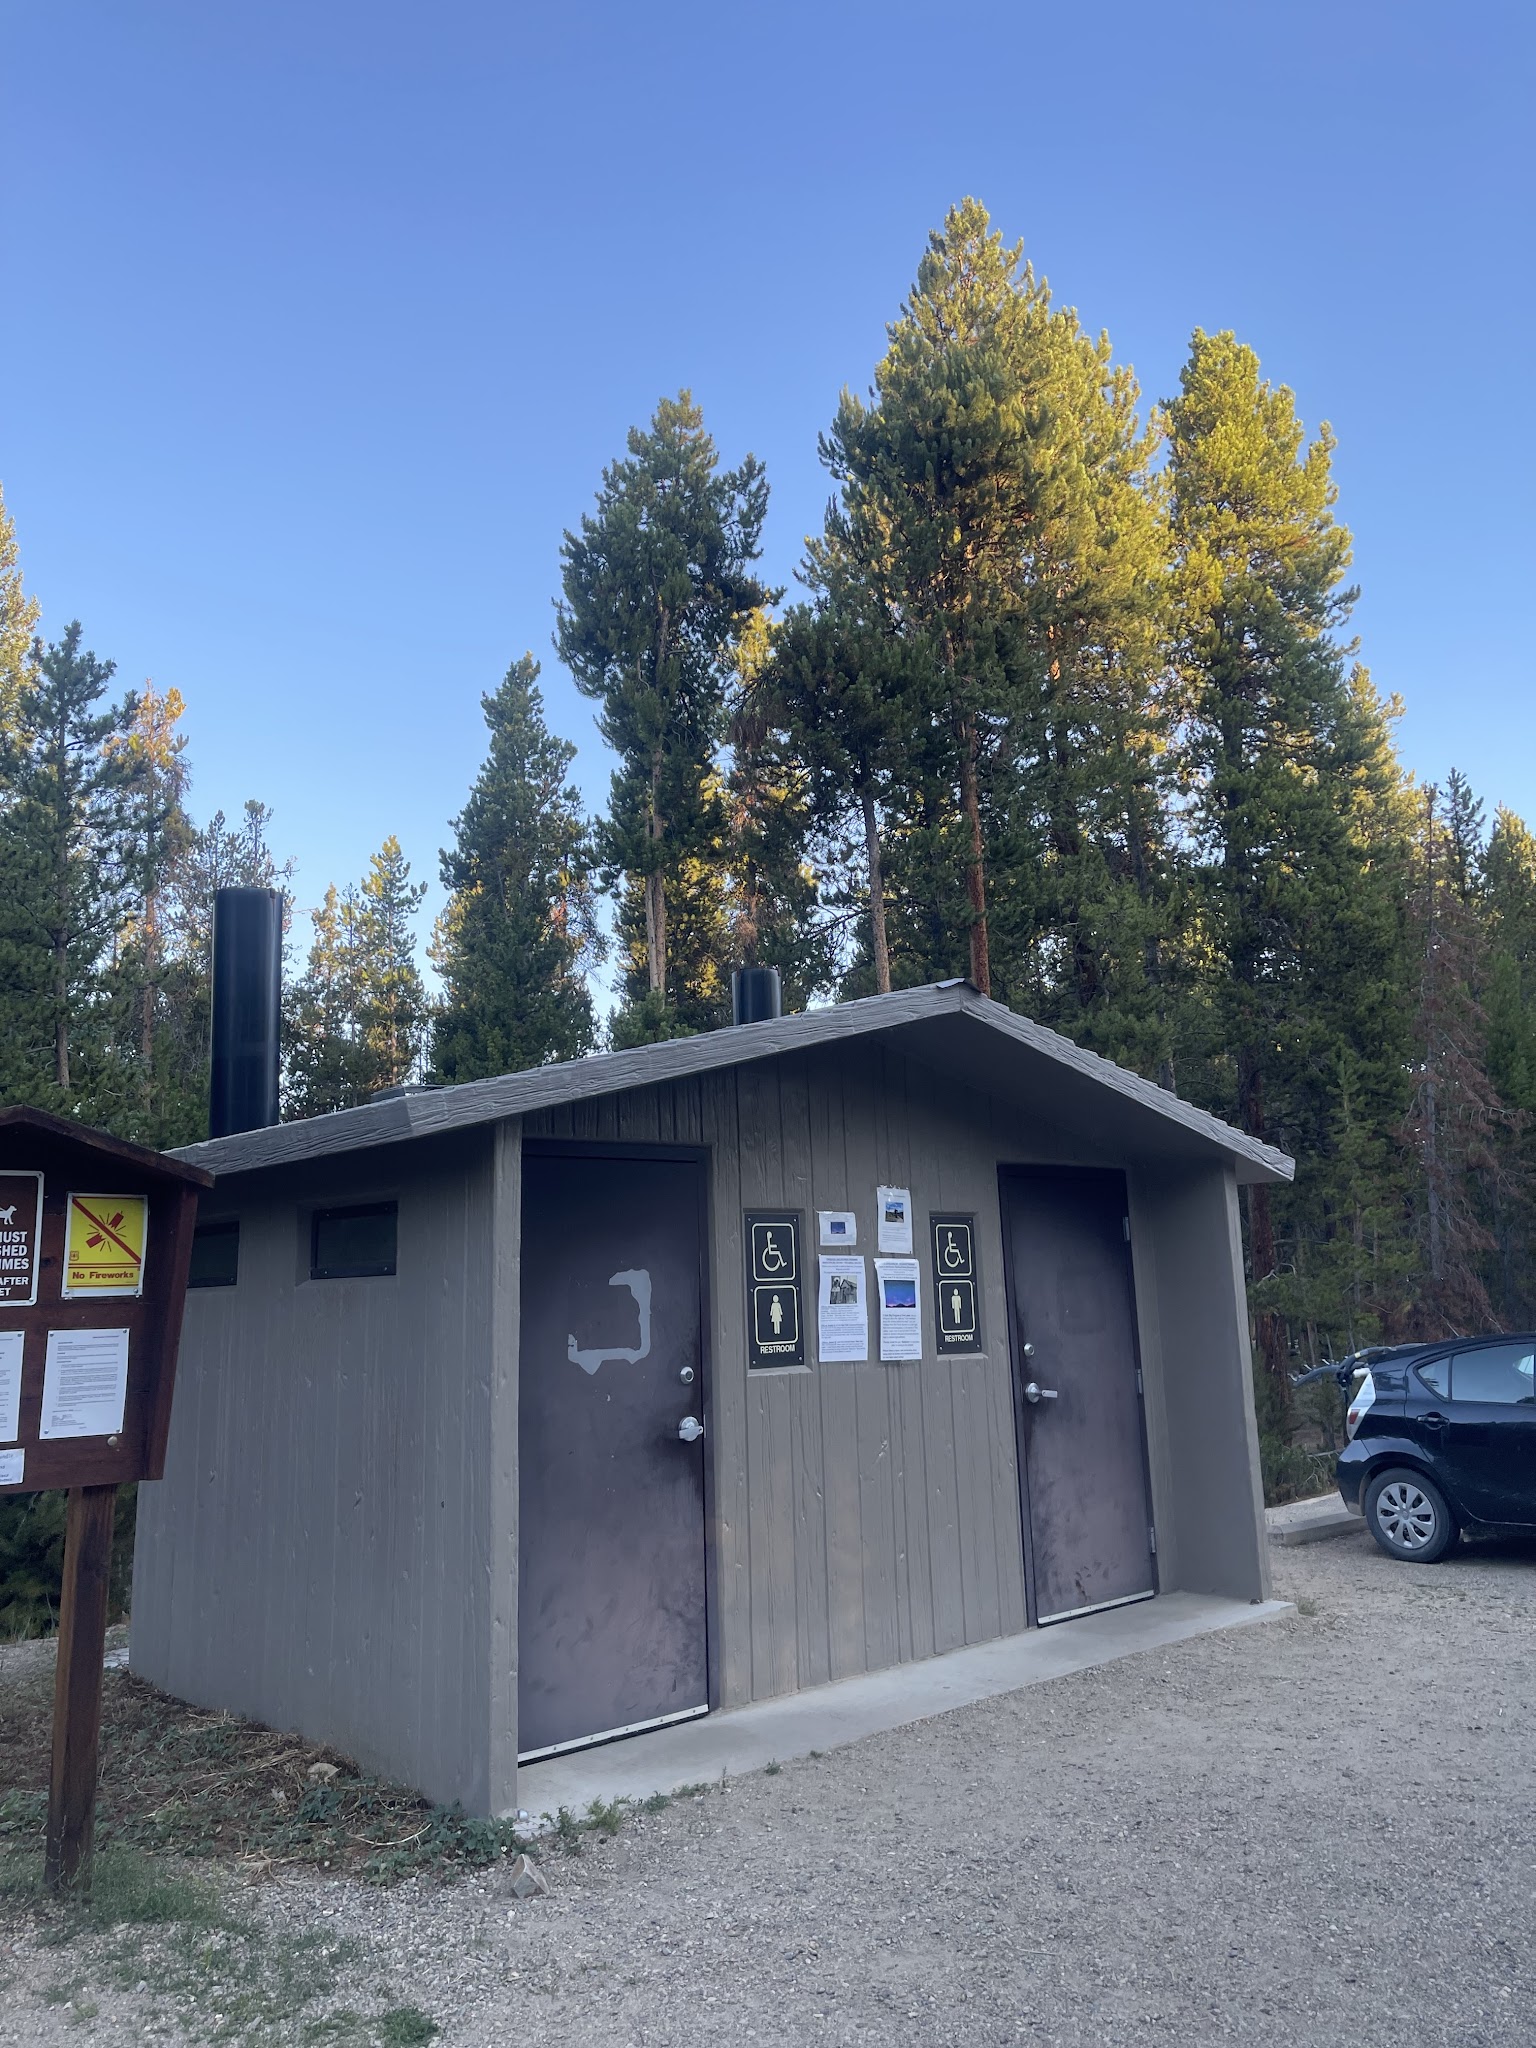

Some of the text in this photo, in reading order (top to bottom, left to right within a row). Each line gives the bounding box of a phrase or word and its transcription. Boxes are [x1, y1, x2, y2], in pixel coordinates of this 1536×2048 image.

[0, 1231, 28, 1243] UST
[0, 1244, 28, 1257] HED
[72, 1271, 134, 1279] No Fireworks
[945, 1334, 974, 1342] RESTROOM
[760, 1344, 796, 1354] RESTROOM
